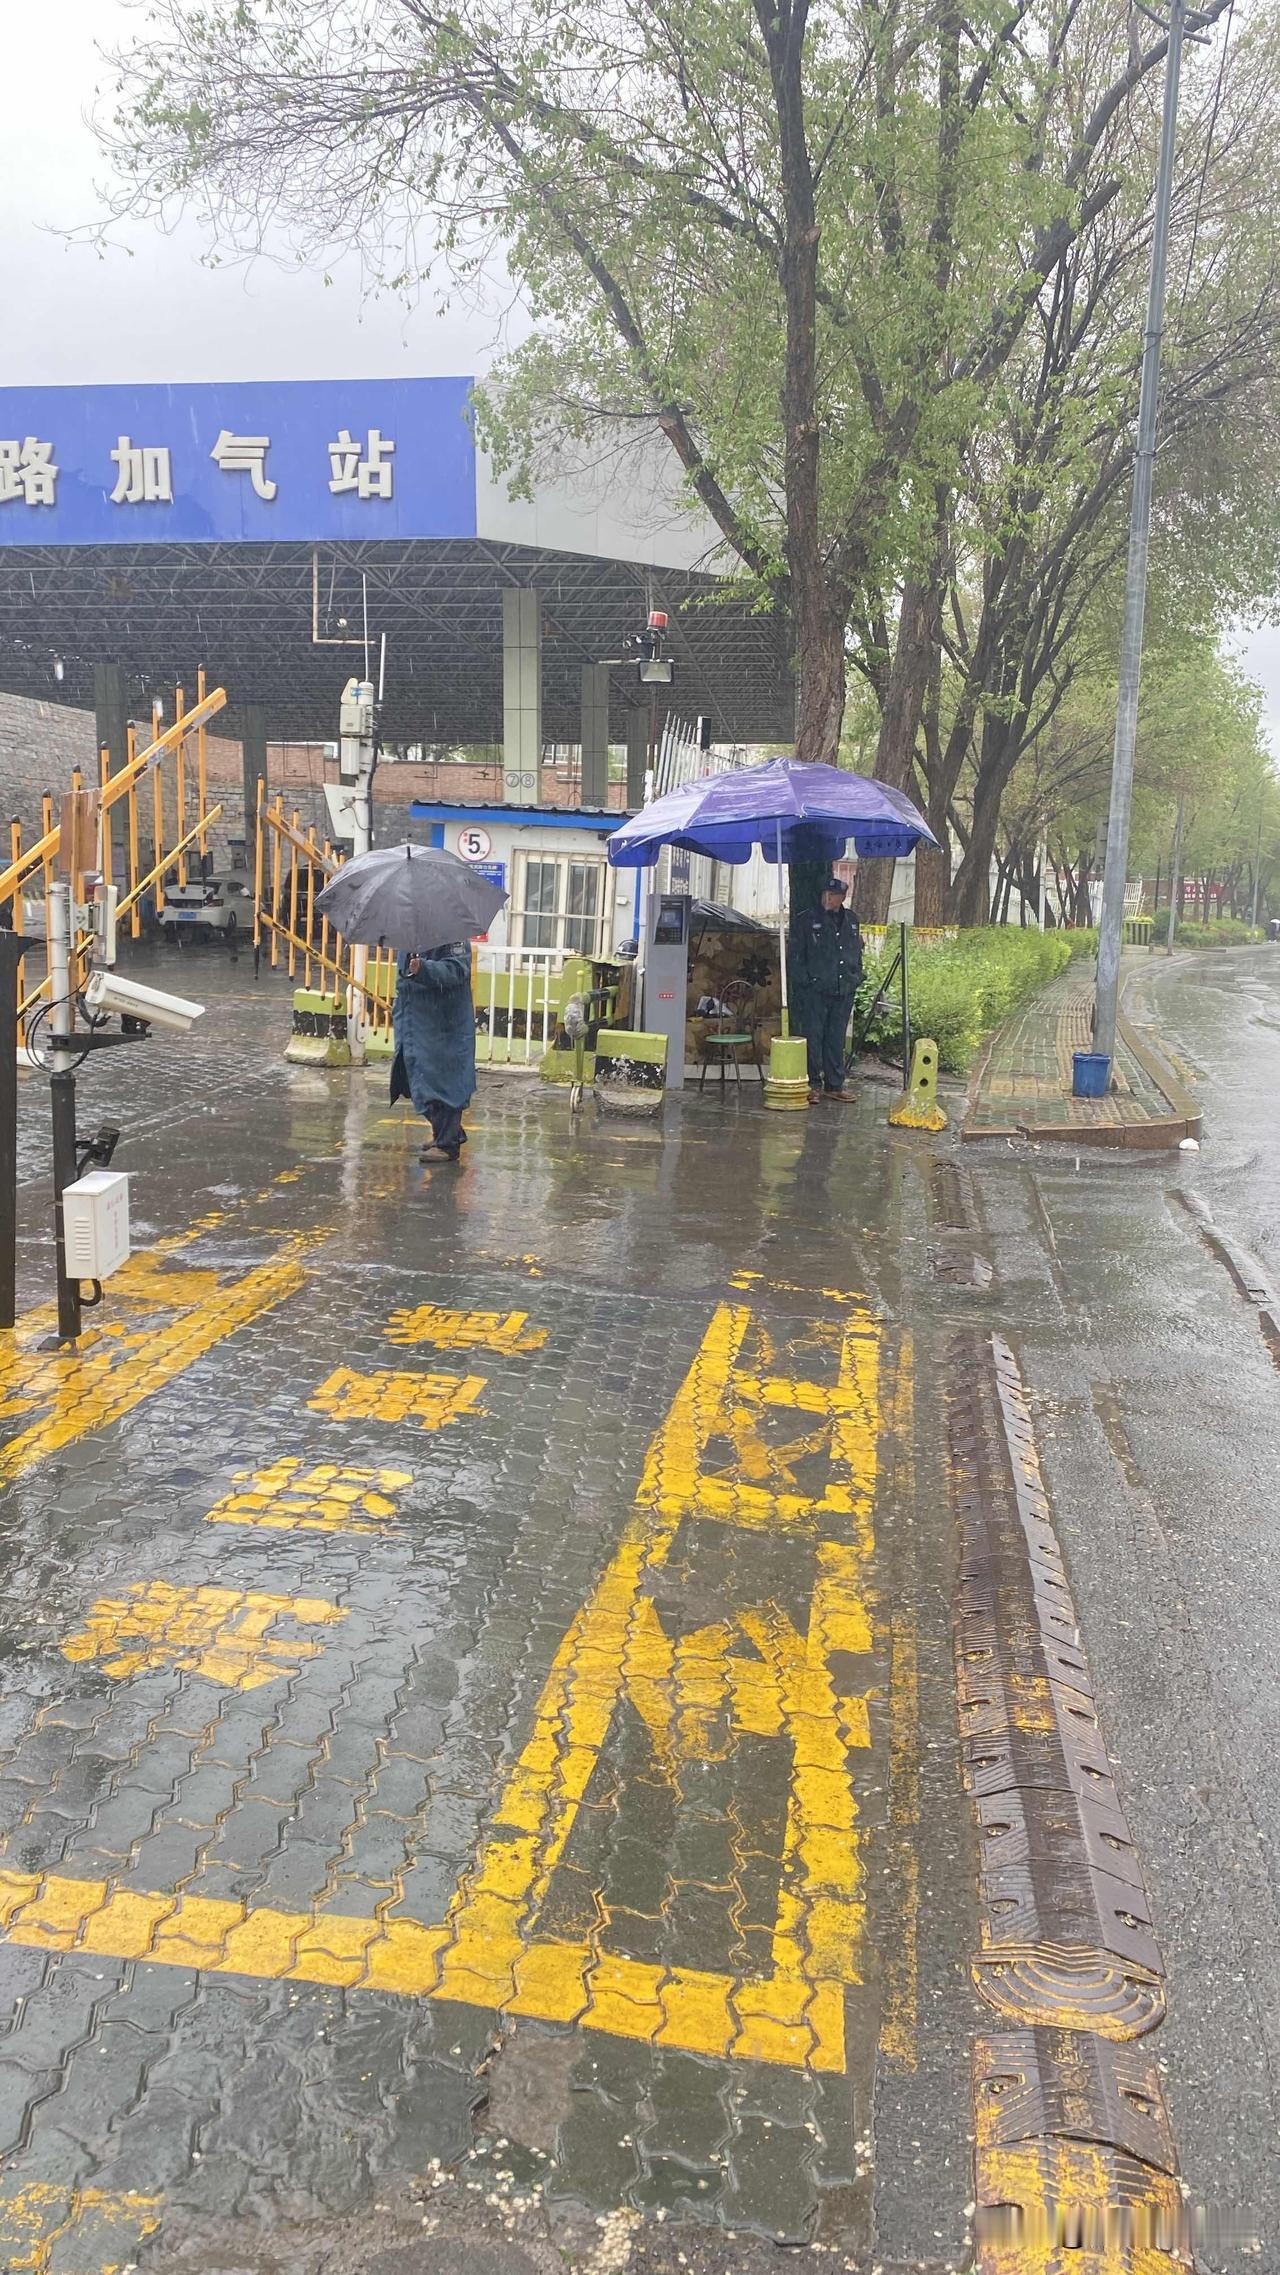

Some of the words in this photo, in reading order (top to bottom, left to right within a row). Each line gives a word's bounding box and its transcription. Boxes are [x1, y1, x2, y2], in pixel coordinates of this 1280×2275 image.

[0, 430, 396, 505] 路加气站
[469, 834, 480, 854] 5
